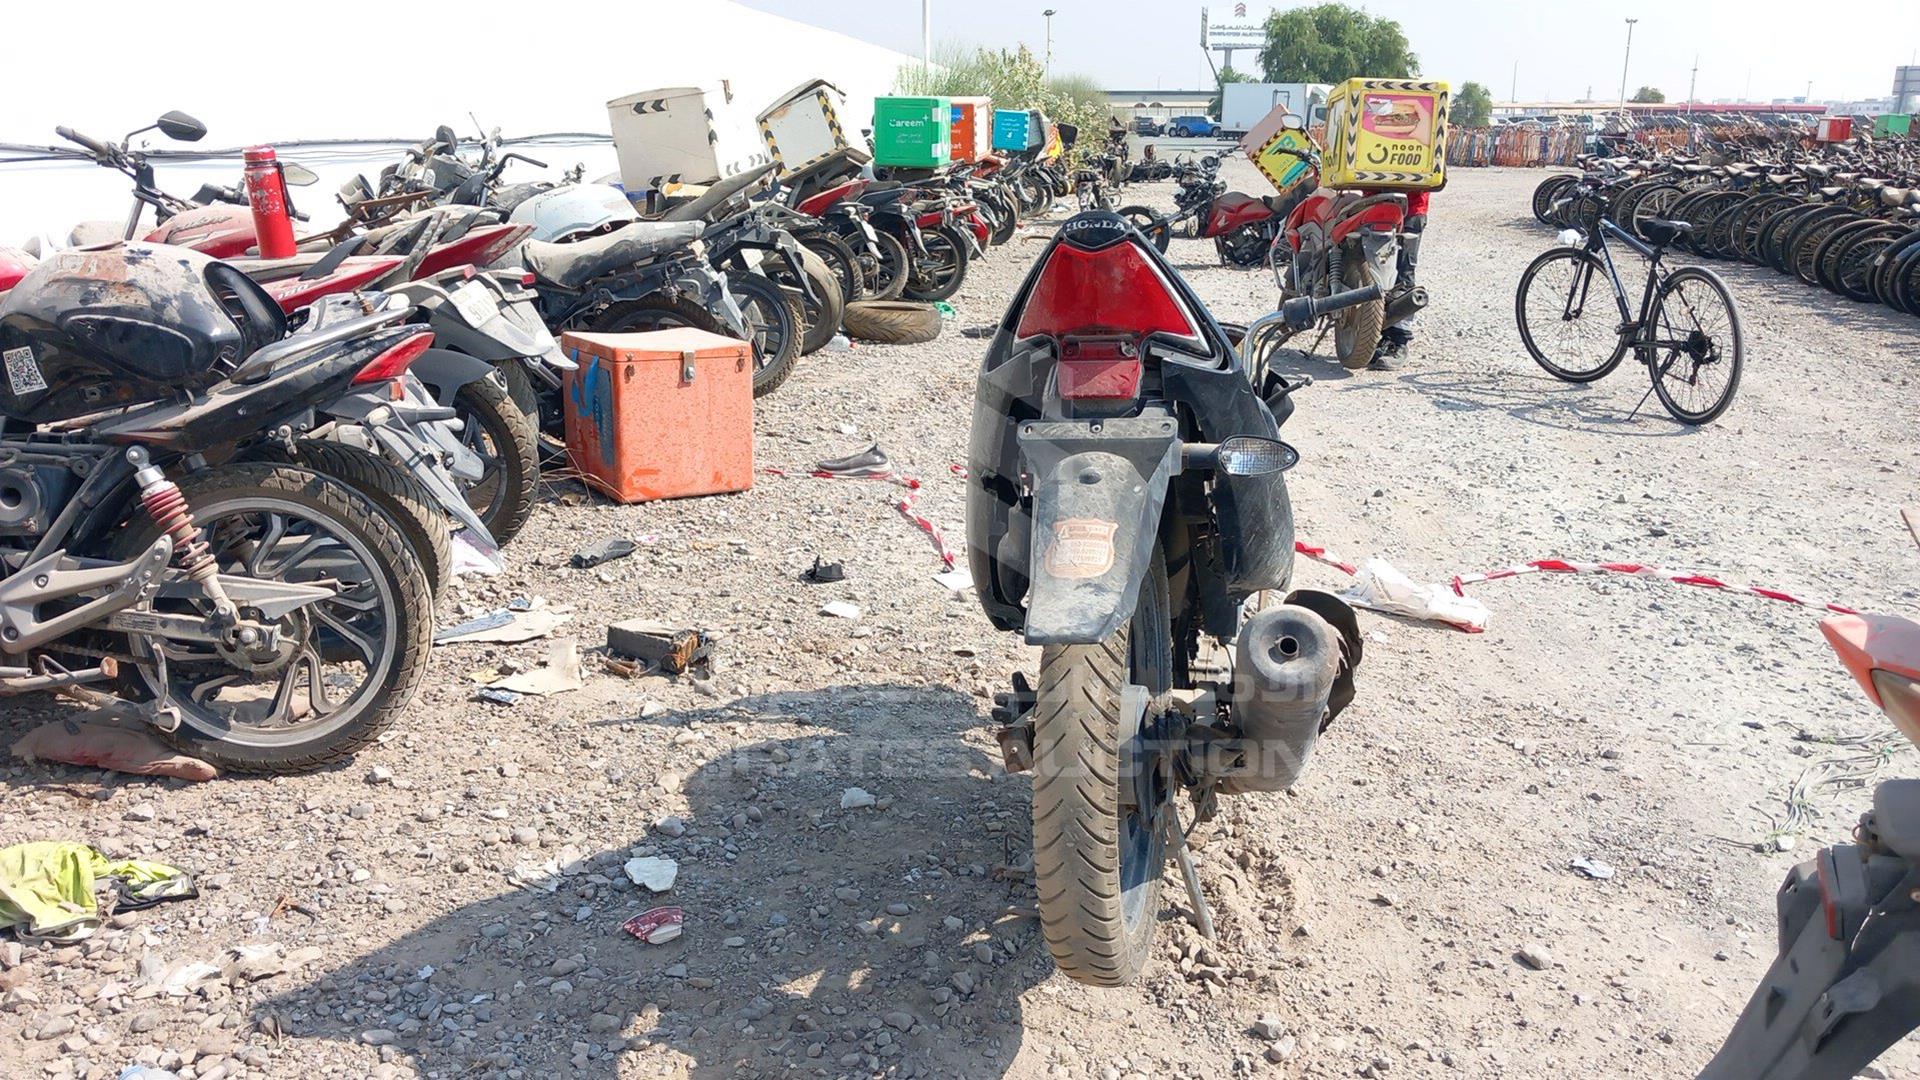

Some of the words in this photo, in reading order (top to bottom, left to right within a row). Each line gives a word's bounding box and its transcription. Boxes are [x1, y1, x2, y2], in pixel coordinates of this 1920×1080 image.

[1391, 144, 1423, 152] noon
[1389, 153, 1422, 166] FOOD
[1066, 219, 1126, 232] HONDA
